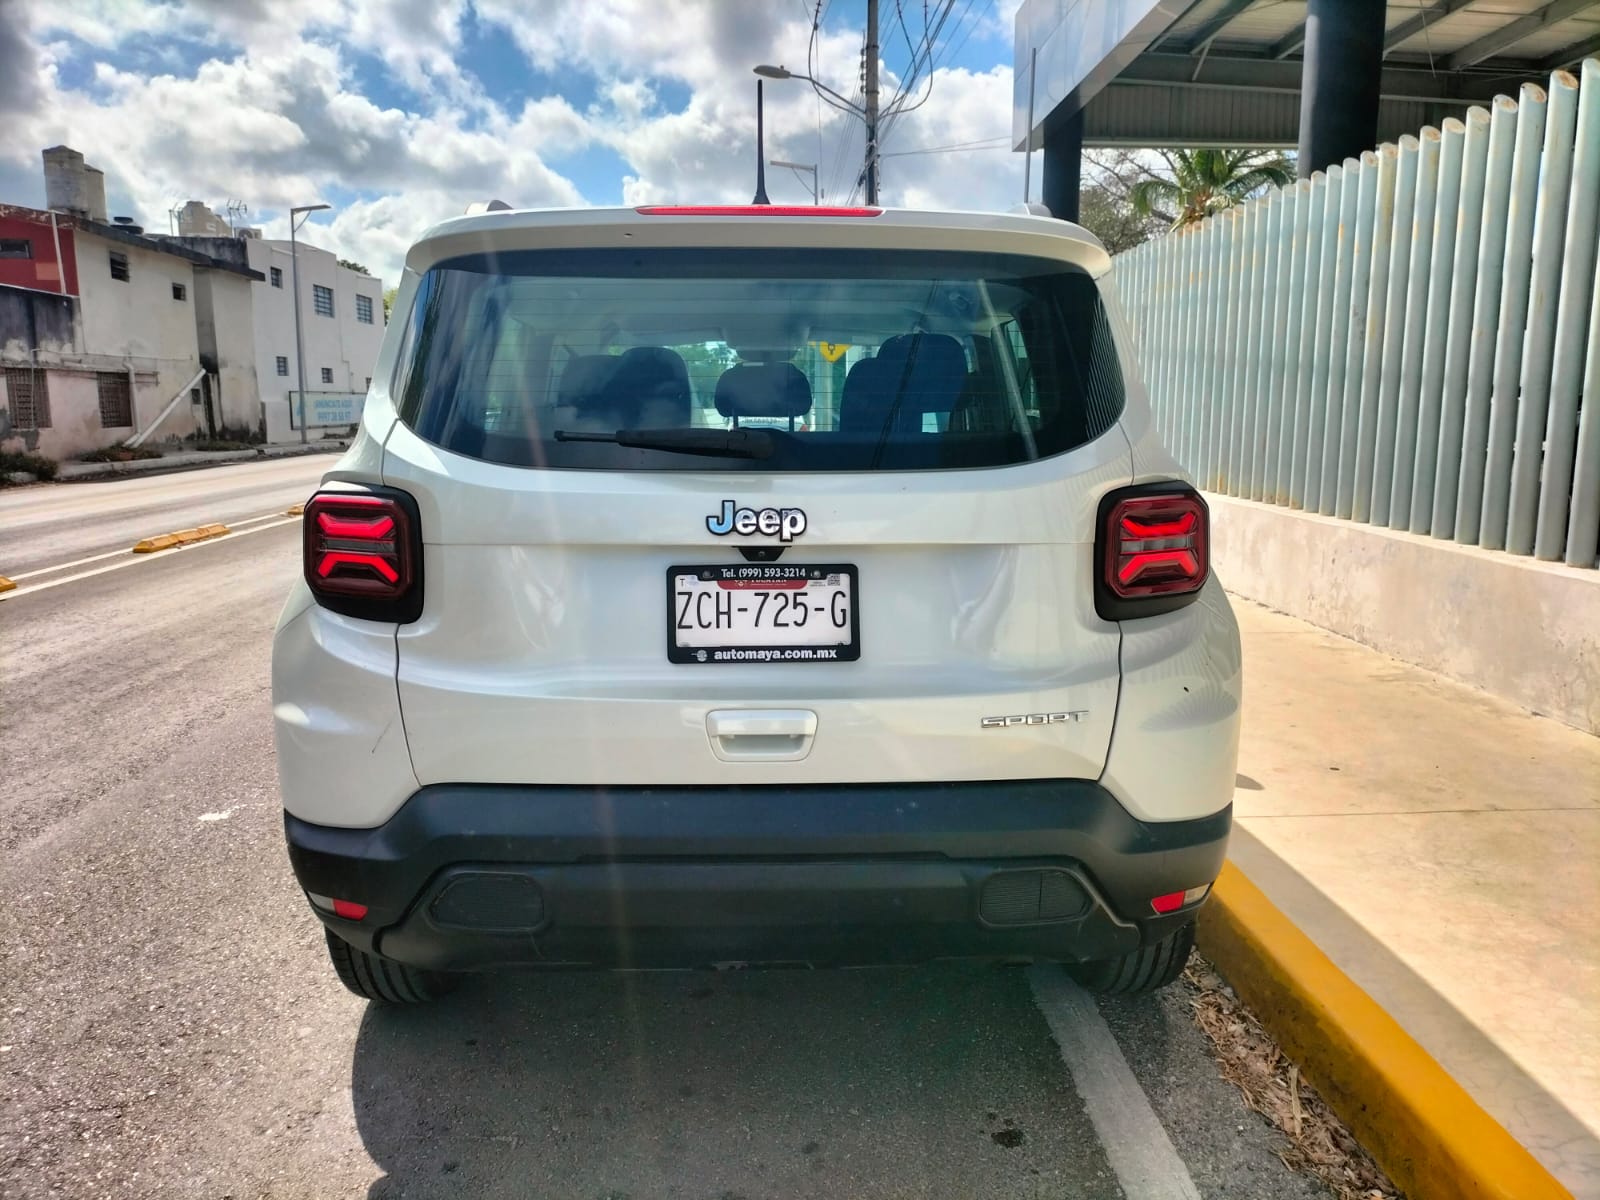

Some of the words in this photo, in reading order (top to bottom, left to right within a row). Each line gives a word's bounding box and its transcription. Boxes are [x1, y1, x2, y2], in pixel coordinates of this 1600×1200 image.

[706, 499, 807, 543] Jeep
[721, 568, 736, 578] Tel.
[738, 568, 762, 579] (999)
[764, 568, 806, 578] 593-3214
[677, 590, 848, 630] ZCH-725-G
[713, 648, 838, 661] automaya.com.mx
[981, 709, 1089, 729] SPORT
